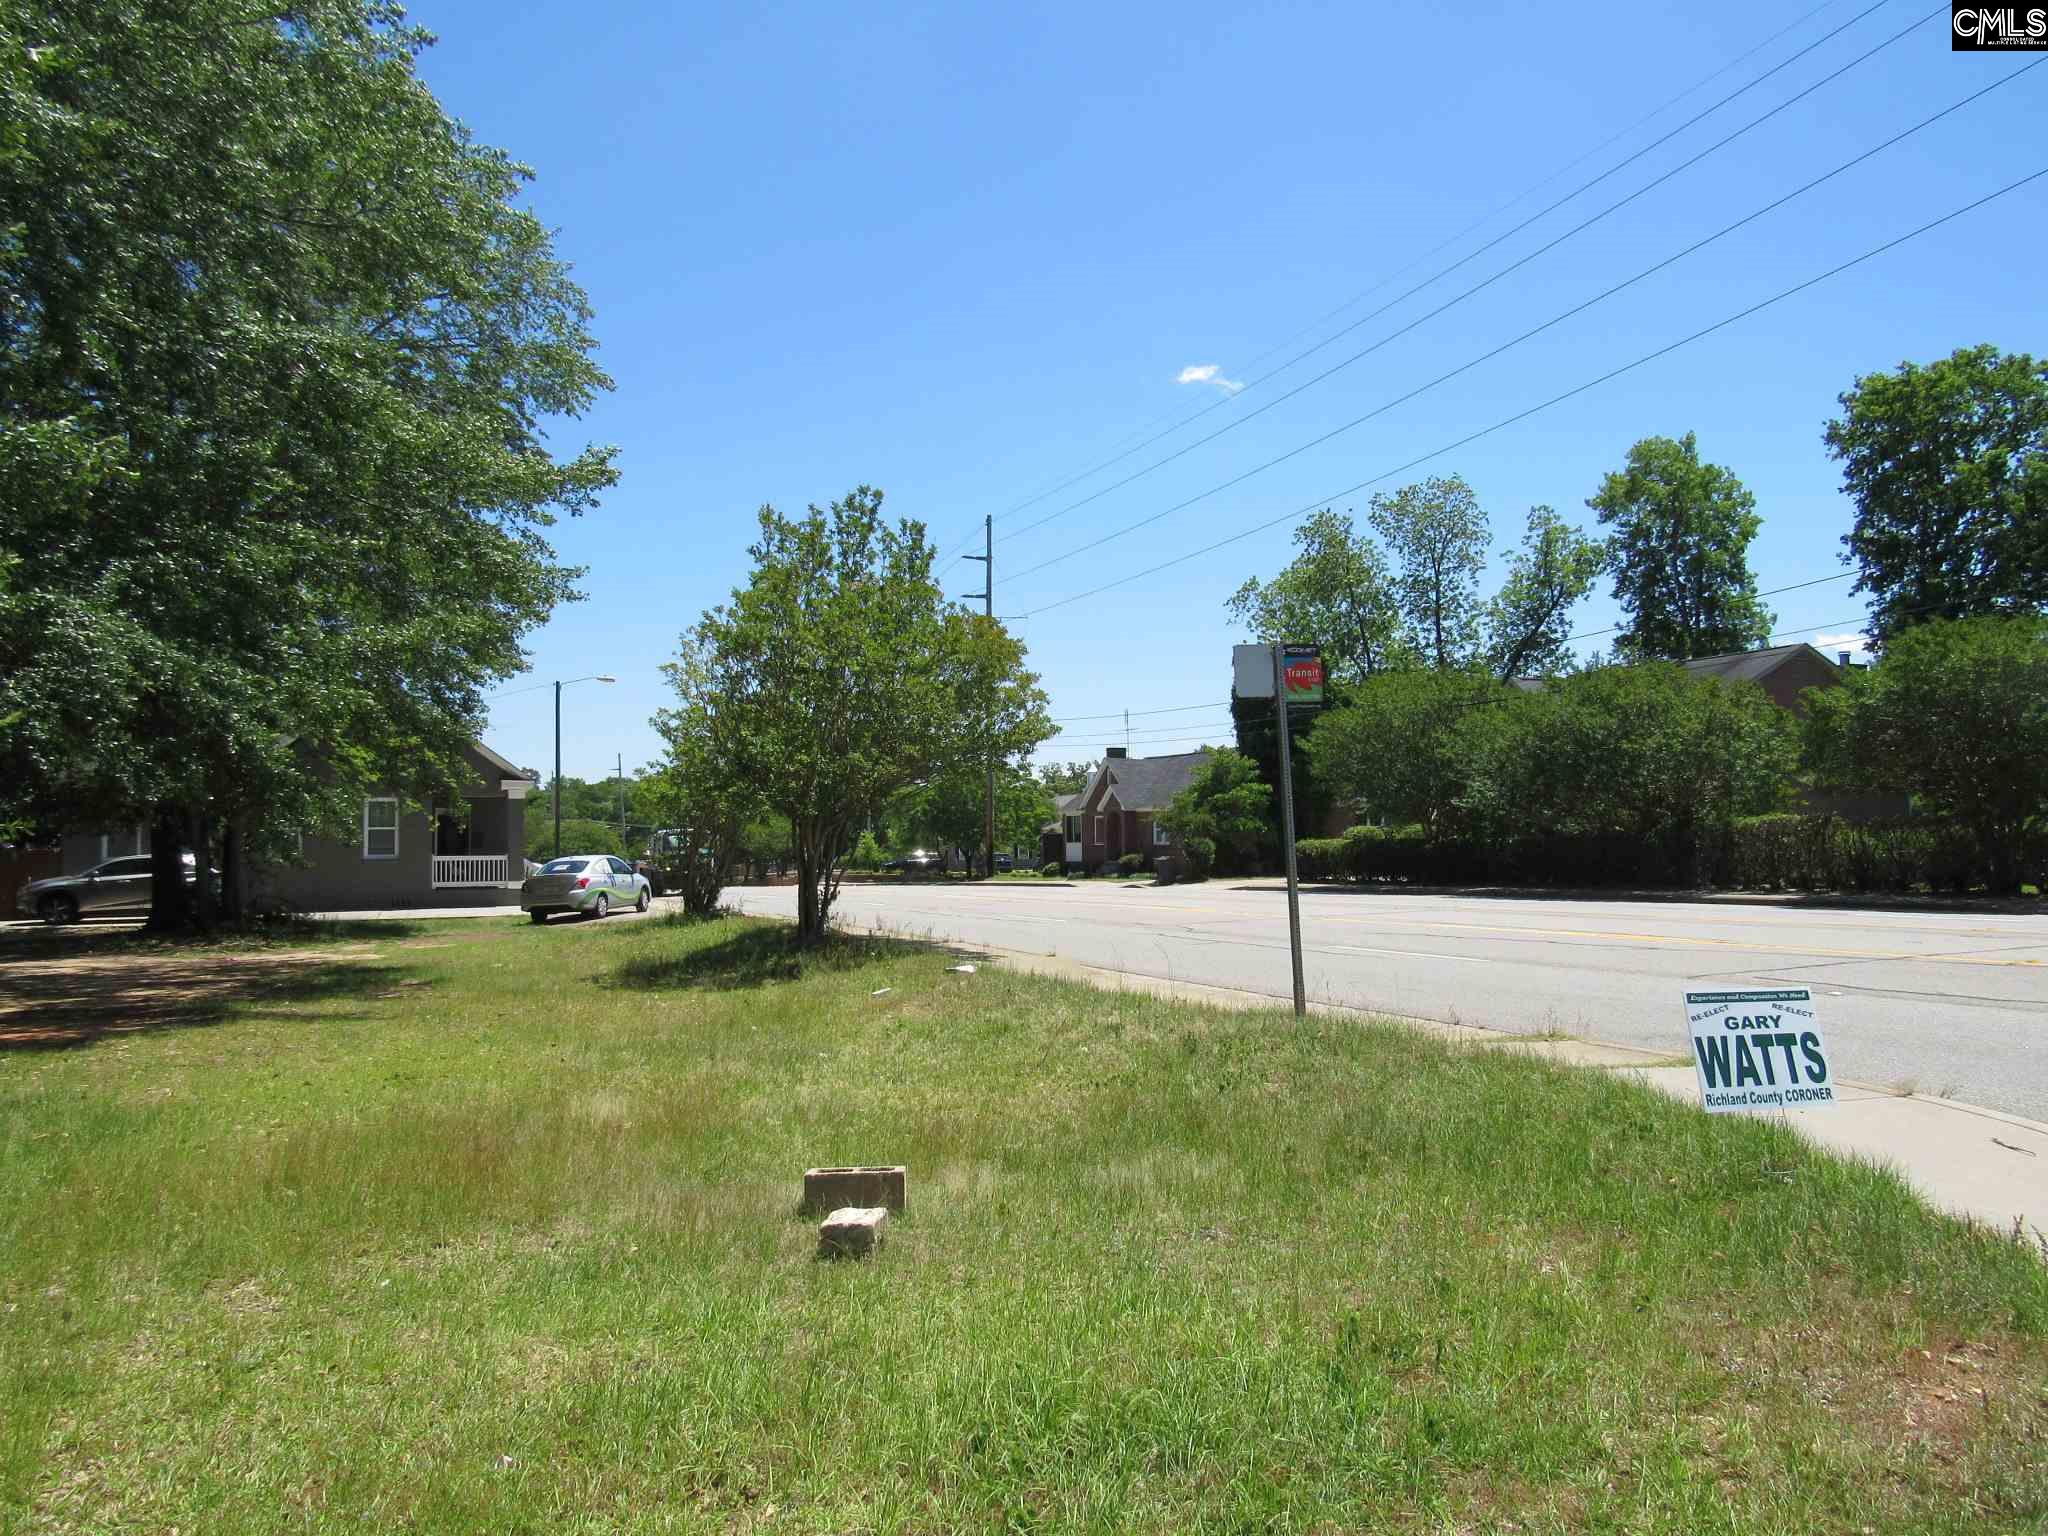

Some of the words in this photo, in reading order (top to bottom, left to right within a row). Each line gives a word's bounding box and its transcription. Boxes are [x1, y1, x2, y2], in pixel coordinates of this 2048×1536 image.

[1287, 668, 1320, 679] Transit
[1691, 1005, 1729, 1022] RE-ELECT
[1772, 1003, 1814, 1018] RE-ELECT
[1724, 1014, 1781, 1030] GARY
[1694, 1031, 1827, 1089] WATTS
[1705, 1091, 1748, 1107] Richland
[1751, 1091, 1782, 1106] County
[1785, 1087, 1833, 1102] CORONER
